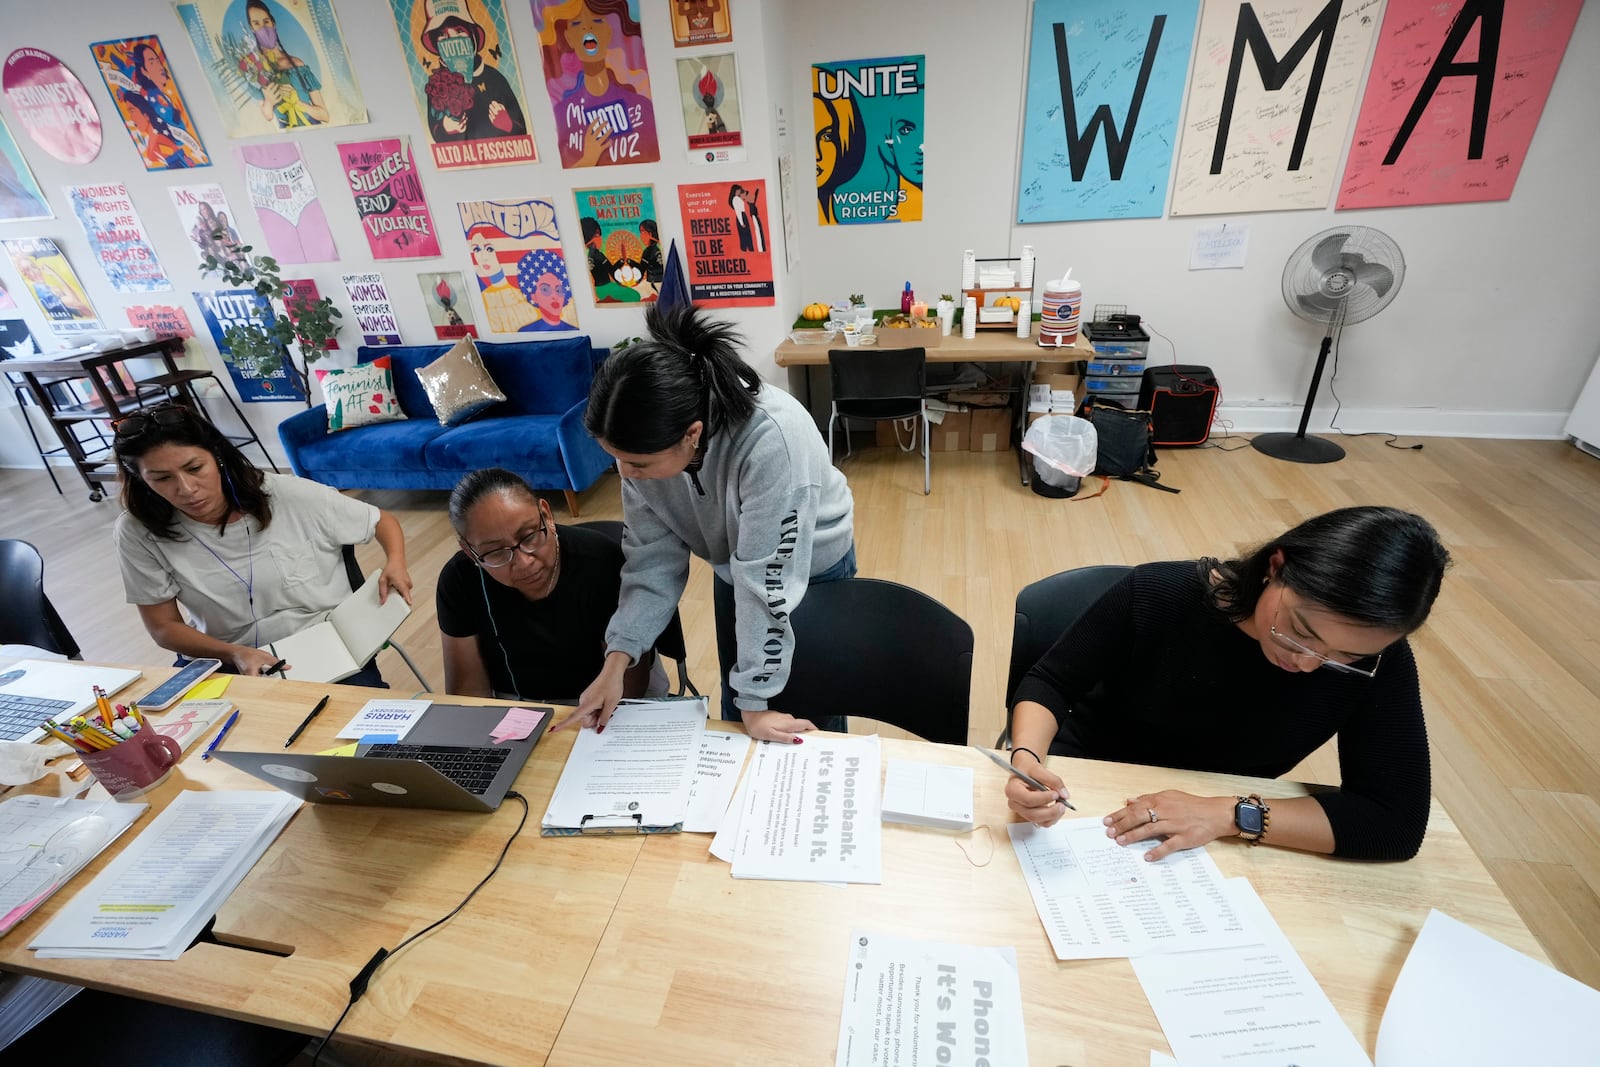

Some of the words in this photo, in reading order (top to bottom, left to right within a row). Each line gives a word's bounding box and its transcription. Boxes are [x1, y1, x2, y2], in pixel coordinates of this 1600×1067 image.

[818, 64, 918, 100] UNITE
[1209, 0, 1343, 175] M
[1381, 0, 1504, 165] A
[1052, 14, 1168, 182] W
[436, 145, 460, 164] ALTO
[464, 145, 476, 162] AL
[477, 138, 532, 161] FASCISMO
[608, 133, 641, 162] VOZ
[283, 164, 304, 181] FILTHY
[349, 138, 411, 192] SILENCE!
[79, 185, 127, 198] WOMEN'S
[394, 173, 424, 203] GUN
[833, 190, 908, 204] WOMEN'S
[94, 201, 130, 213] RIGHTS
[362, 194, 391, 214] END
[589, 195, 616, 206] BLACK
[618, 193, 643, 205] LIVES
[114, 216, 135, 226] ARE
[596, 206, 640, 218] MATTER
[842, 205, 898, 218] RIGHTS
[96, 229, 141, 244] HUMAN
[365, 215, 430, 237] VIOLENCE
[690, 218, 731, 234] REFUSE
[693, 240, 706, 255] TO
[710, 239, 724, 254] BE
[696, 258, 750, 275] SILENCED.
[342, 274, 380, 284] EMPOWERED
[346, 284, 387, 302] WOMEN
[204, 295, 261, 319] VOTE
[352, 304, 392, 316] EMPOWER
[357, 315, 396, 332] WOMEN
[326, 374, 386, 398] Feminist
[345, 391, 368, 413] AF
[776, 509, 798, 561] THE
[765, 563, 788, 624] ERAS
[752, 627, 786, 683] TOUR
[364, 712, 412, 720] HARRIS
[818, 750, 834, 777] It's
[812, 781, 832, 834] Worth
[840, 756, 860, 862] Phonebank.
[810, 840, 827, 862] It.
[887, 962, 895, 1002] opportunity
[936, 964, 958, 1012] It's
[884, 1037, 891, 1045] to
[936, 1022, 957, 1067] Wo
